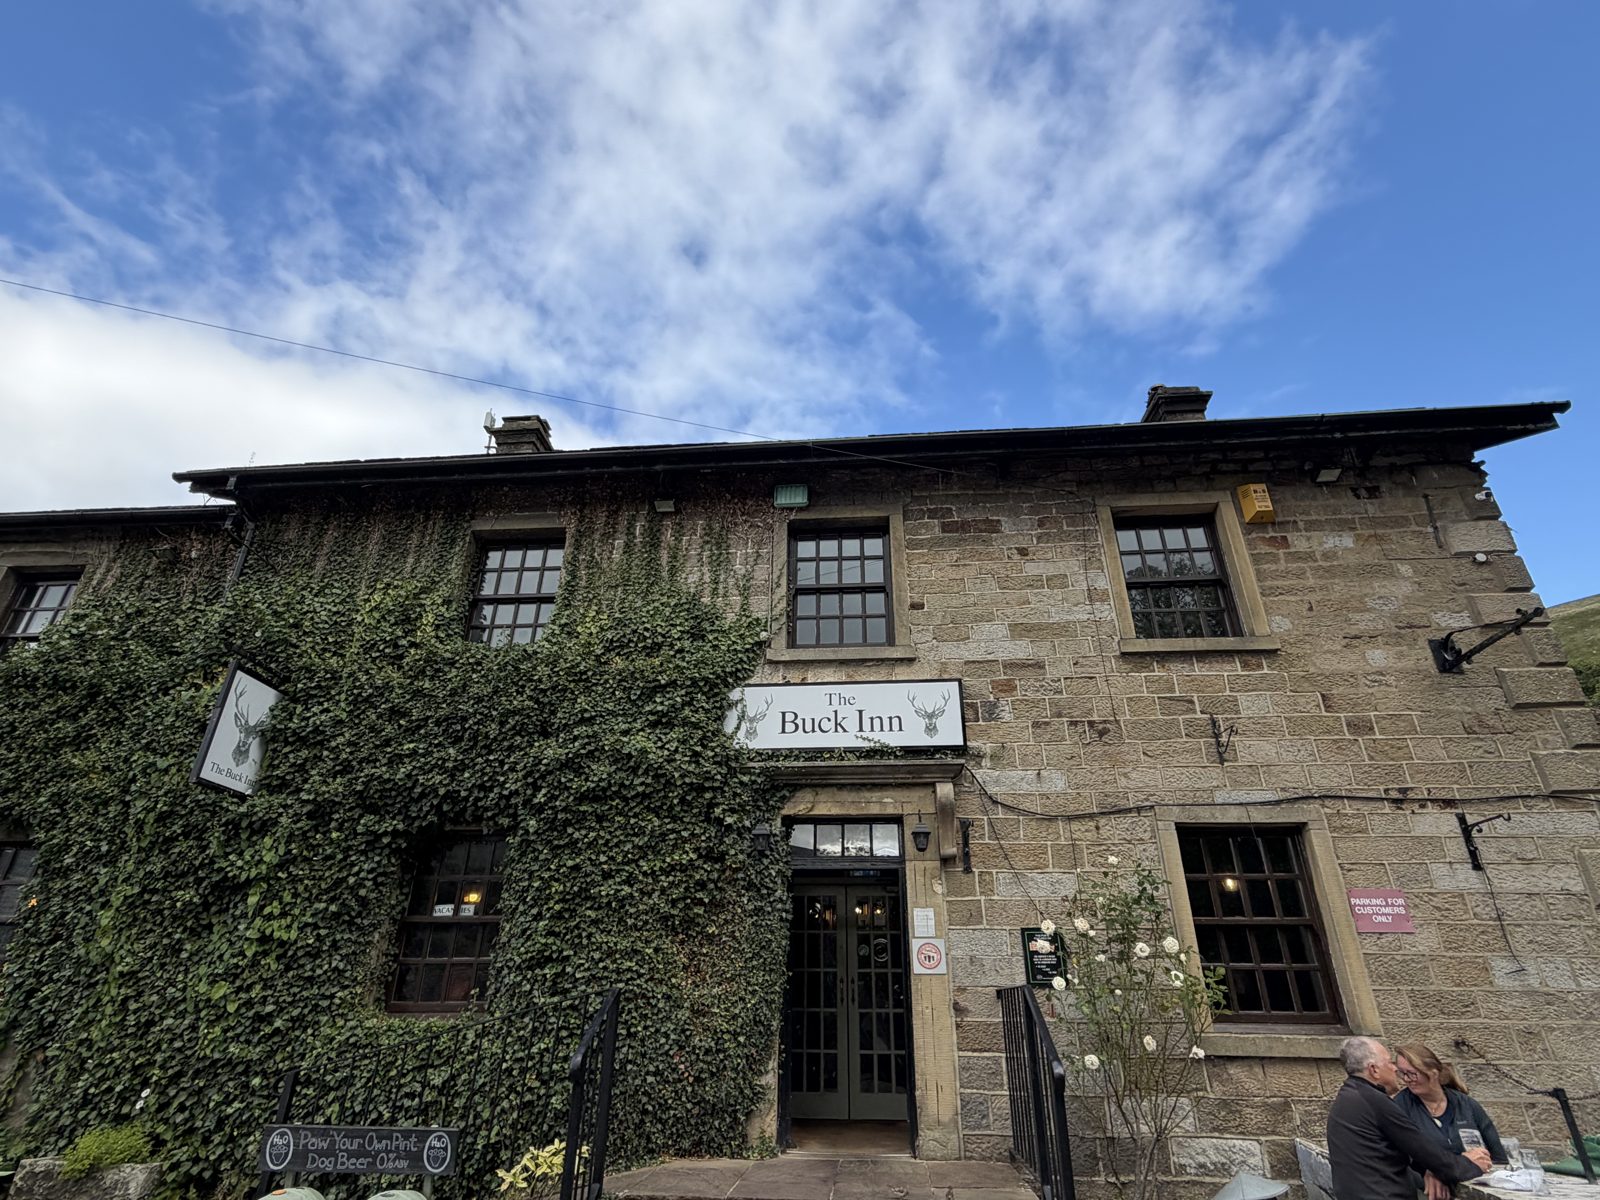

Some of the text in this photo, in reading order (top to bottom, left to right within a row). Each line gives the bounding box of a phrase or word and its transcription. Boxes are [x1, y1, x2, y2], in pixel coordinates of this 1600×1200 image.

[824, 692, 857, 707] The
[778, 709, 905, 735] Buck Inn
[210, 761, 258, 788] The Buck Inn
[1350, 897, 1406, 906] PARKING FOR
[1355, 906, 1406, 914] CUSTOMERS
[1372, 915, 1393, 923] ONLY
[364, 1132, 391, 1151] Own
[392, 1133, 418, 1151] Pint
[306, 1153, 335, 1171] Dog
